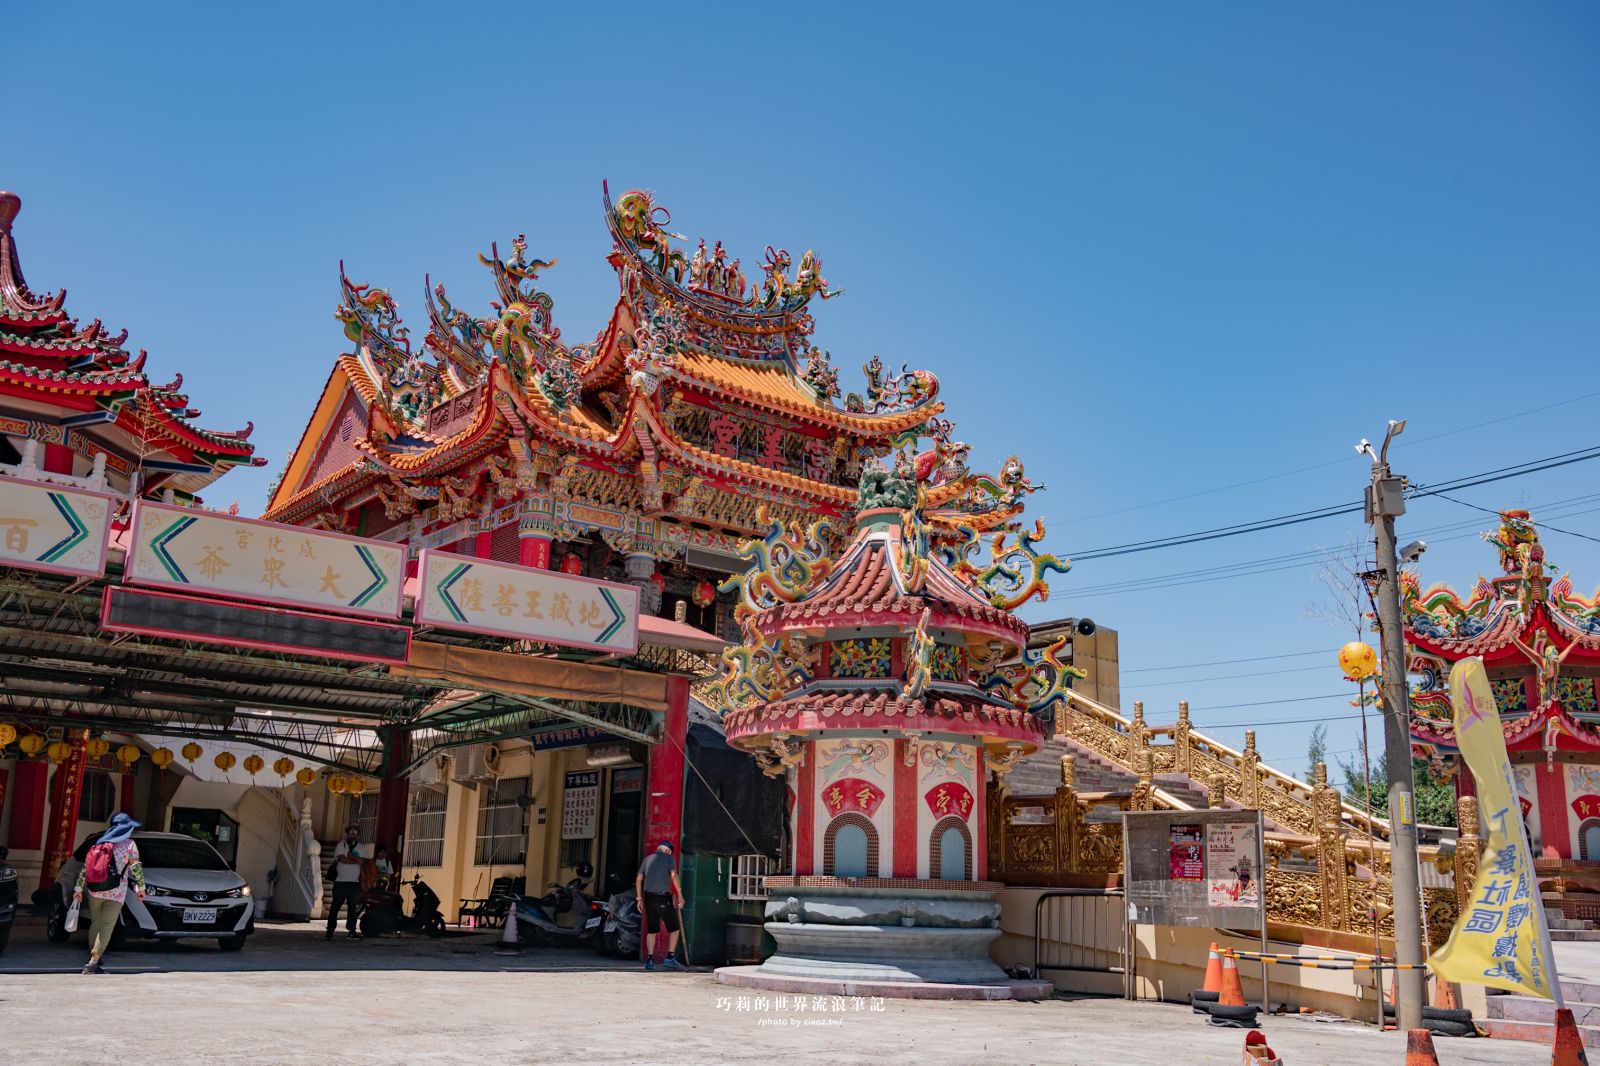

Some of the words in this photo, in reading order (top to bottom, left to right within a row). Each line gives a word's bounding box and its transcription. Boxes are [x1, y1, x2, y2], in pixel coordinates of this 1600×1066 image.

[458, 578, 606, 628] 地藏王菩薩
